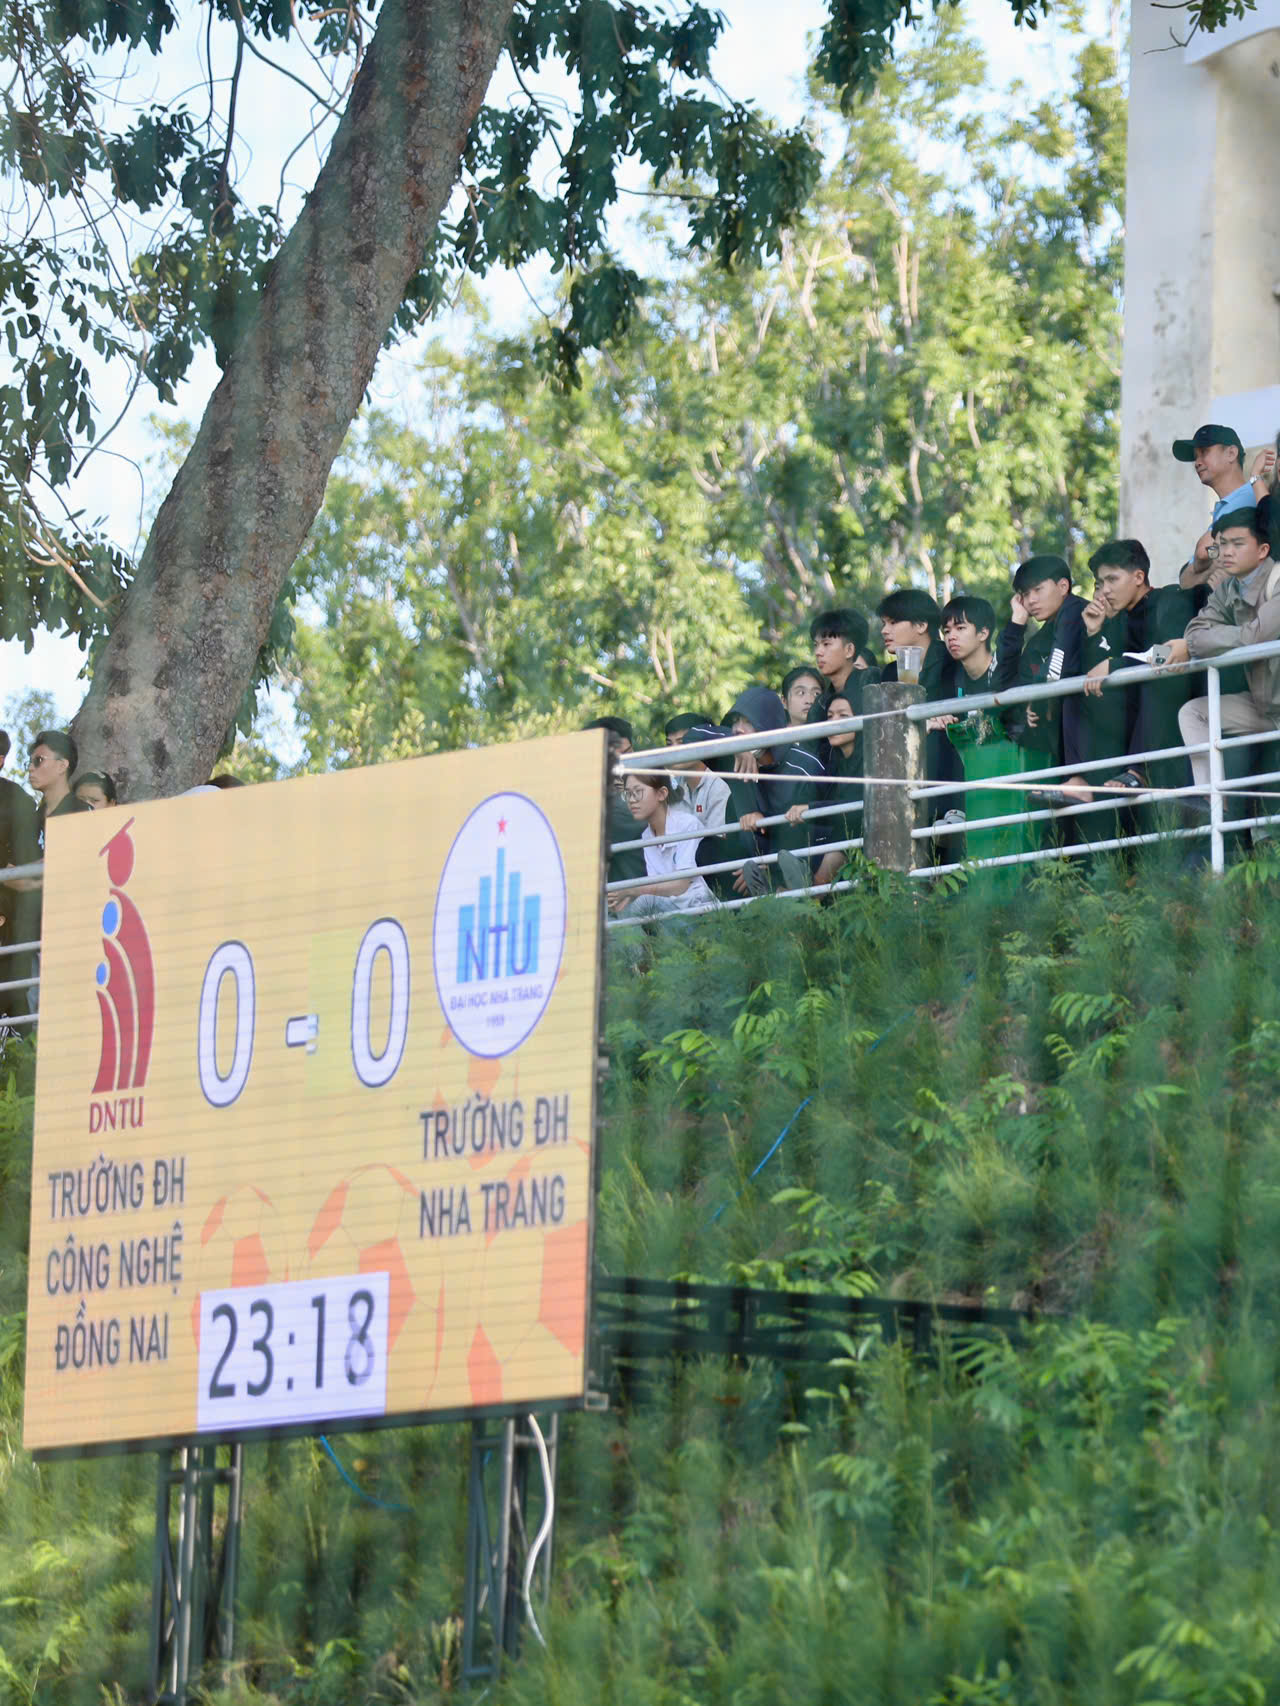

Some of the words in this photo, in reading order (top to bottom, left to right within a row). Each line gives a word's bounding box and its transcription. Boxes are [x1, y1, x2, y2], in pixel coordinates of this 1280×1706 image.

[463, 920, 532, 983] NTU
[198, 939, 256, 1109] 0
[351, 916, 411, 1089] 0
[89, 1096, 144, 1134] DNTU
[419, 1091, 524, 1160] TRƯỜNG
[533, 1093, 569, 1146] ĐH
[48, 1153, 145, 1219] TRƯỜNG
[152, 1156, 186, 1207] ĐH
[419, 1185, 472, 1239] NHA
[480, 1174, 566, 1233] TRANG
[46, 1232, 111, 1296] CÔNG
[118, 1219, 184, 1296] NGHỆ
[54, 1298, 121, 1372] ĐỒNG
[128, 1311, 169, 1364] NAI
[208, 1288, 376, 1401] 23:18
